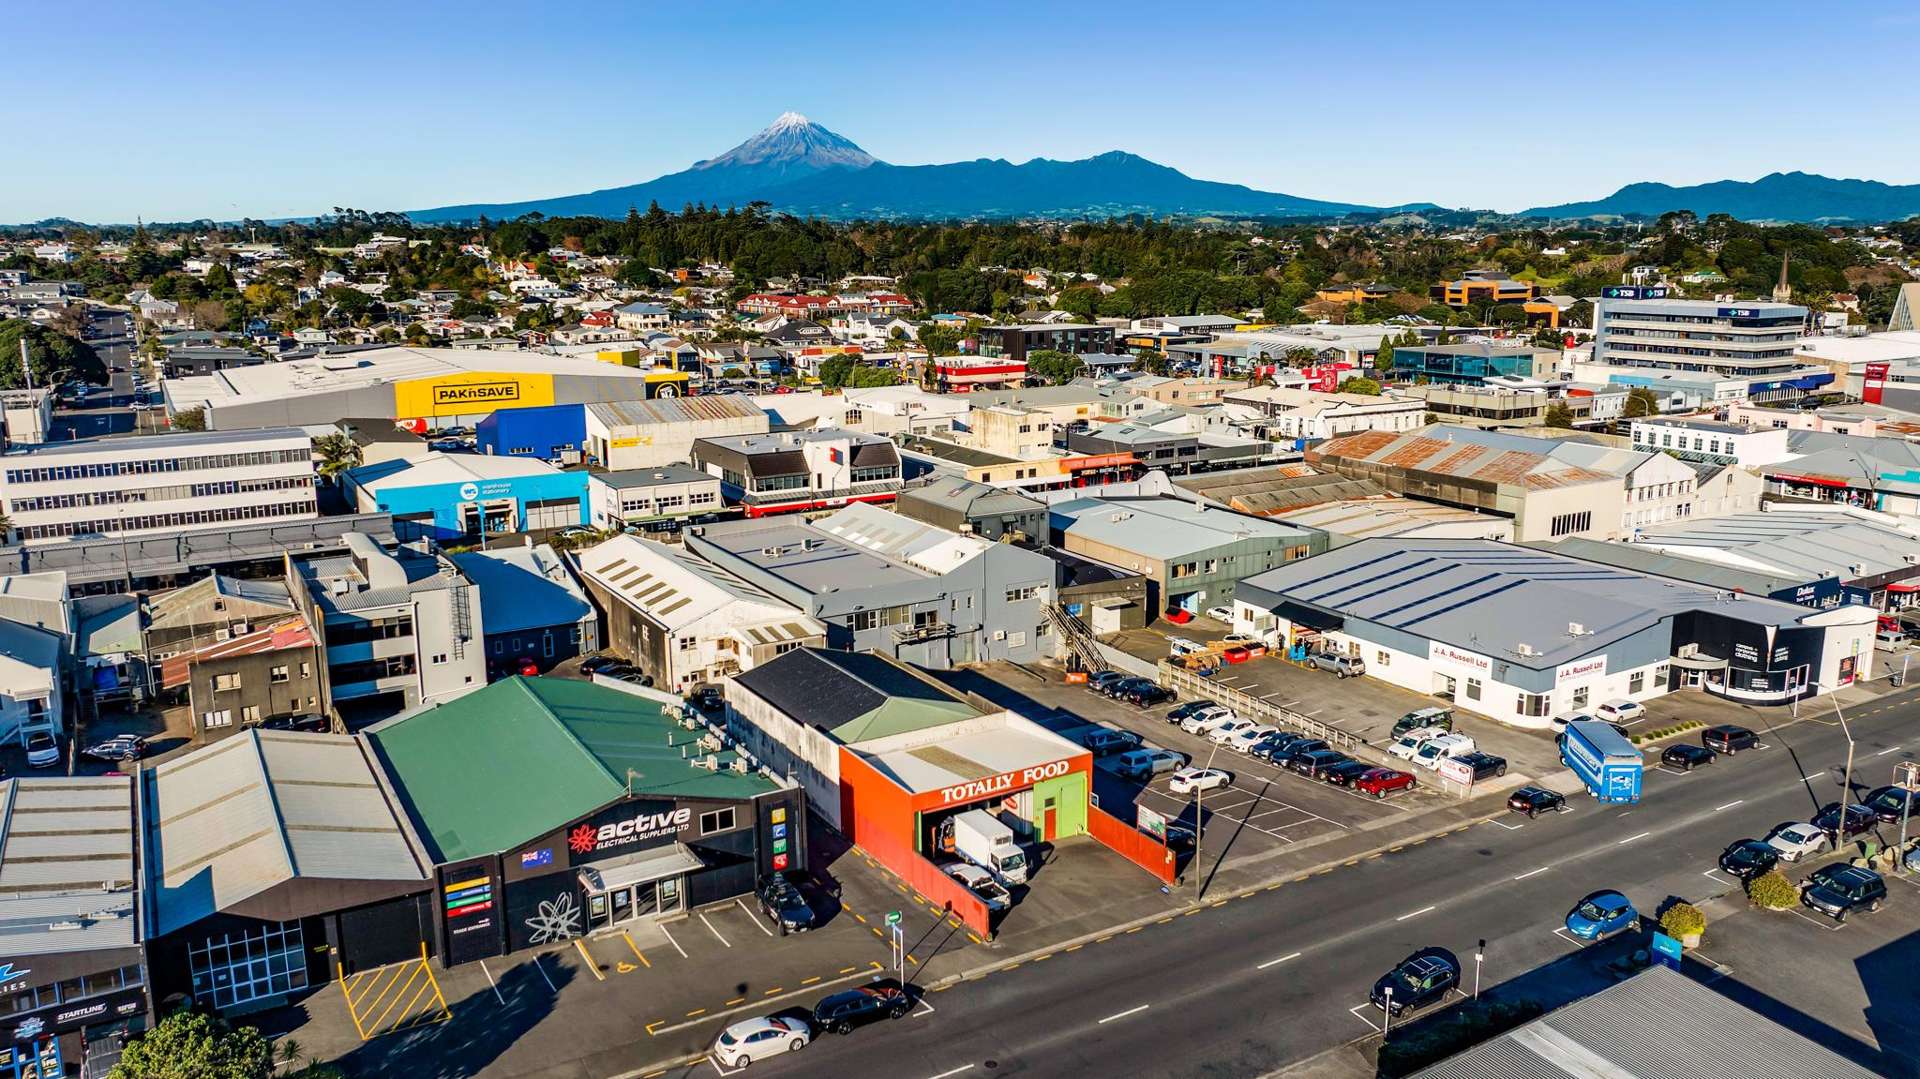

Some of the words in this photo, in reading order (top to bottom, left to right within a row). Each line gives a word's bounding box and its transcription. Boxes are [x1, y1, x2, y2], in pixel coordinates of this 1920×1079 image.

[1619, 289, 1634, 297] TSB
[1653, 289, 1664, 297] TSB
[1449, 651, 1475, 665] Russell
[1475, 659, 1488, 669] Ltd
[1572, 663, 1594, 674] Russell
[1593, 661, 1604, 670] Ltd
[941, 773, 1015, 803] TOTALLY
[1023, 760, 1070, 784] FOOD
[597, 808, 691, 841] active
[596, 834, 638, 850] ELECTRICAL
[639, 825, 676, 840] SUPPLIERS
[676, 823, 690, 832] LTD
[57, 1002, 107, 1021] STARTLINE
